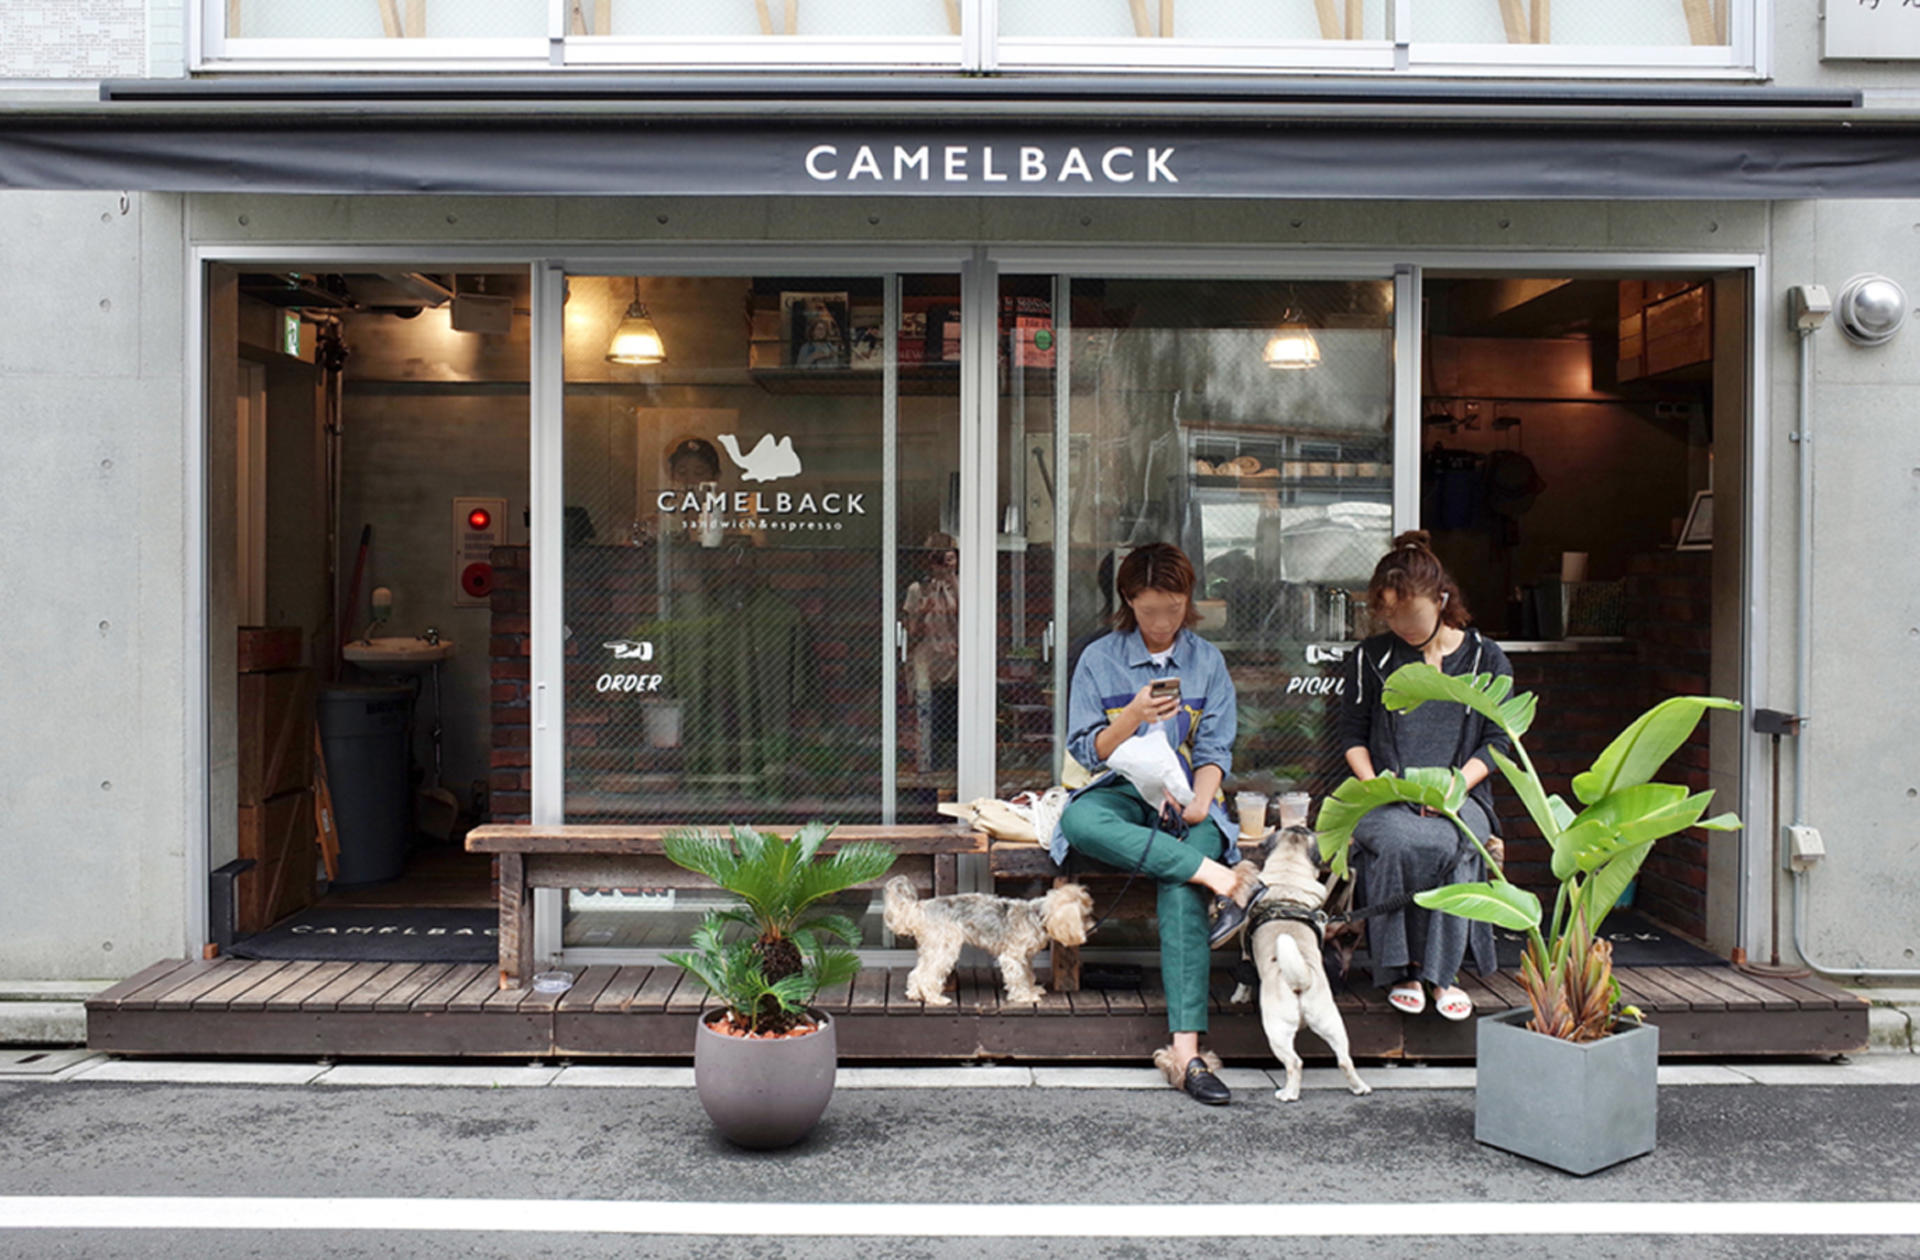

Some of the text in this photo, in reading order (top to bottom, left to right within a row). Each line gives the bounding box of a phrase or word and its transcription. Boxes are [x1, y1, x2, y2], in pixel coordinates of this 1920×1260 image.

[805, 145, 1179, 183] CAMELBACK
[657, 491, 866, 513] CAMELBACK
[681, 519, 843, 532] sandwich&espresso
[596, 673, 663, 693] ORDER
[1286, 676, 1345, 696] PICKU
[291, 925, 499, 936] CAMELBAC
